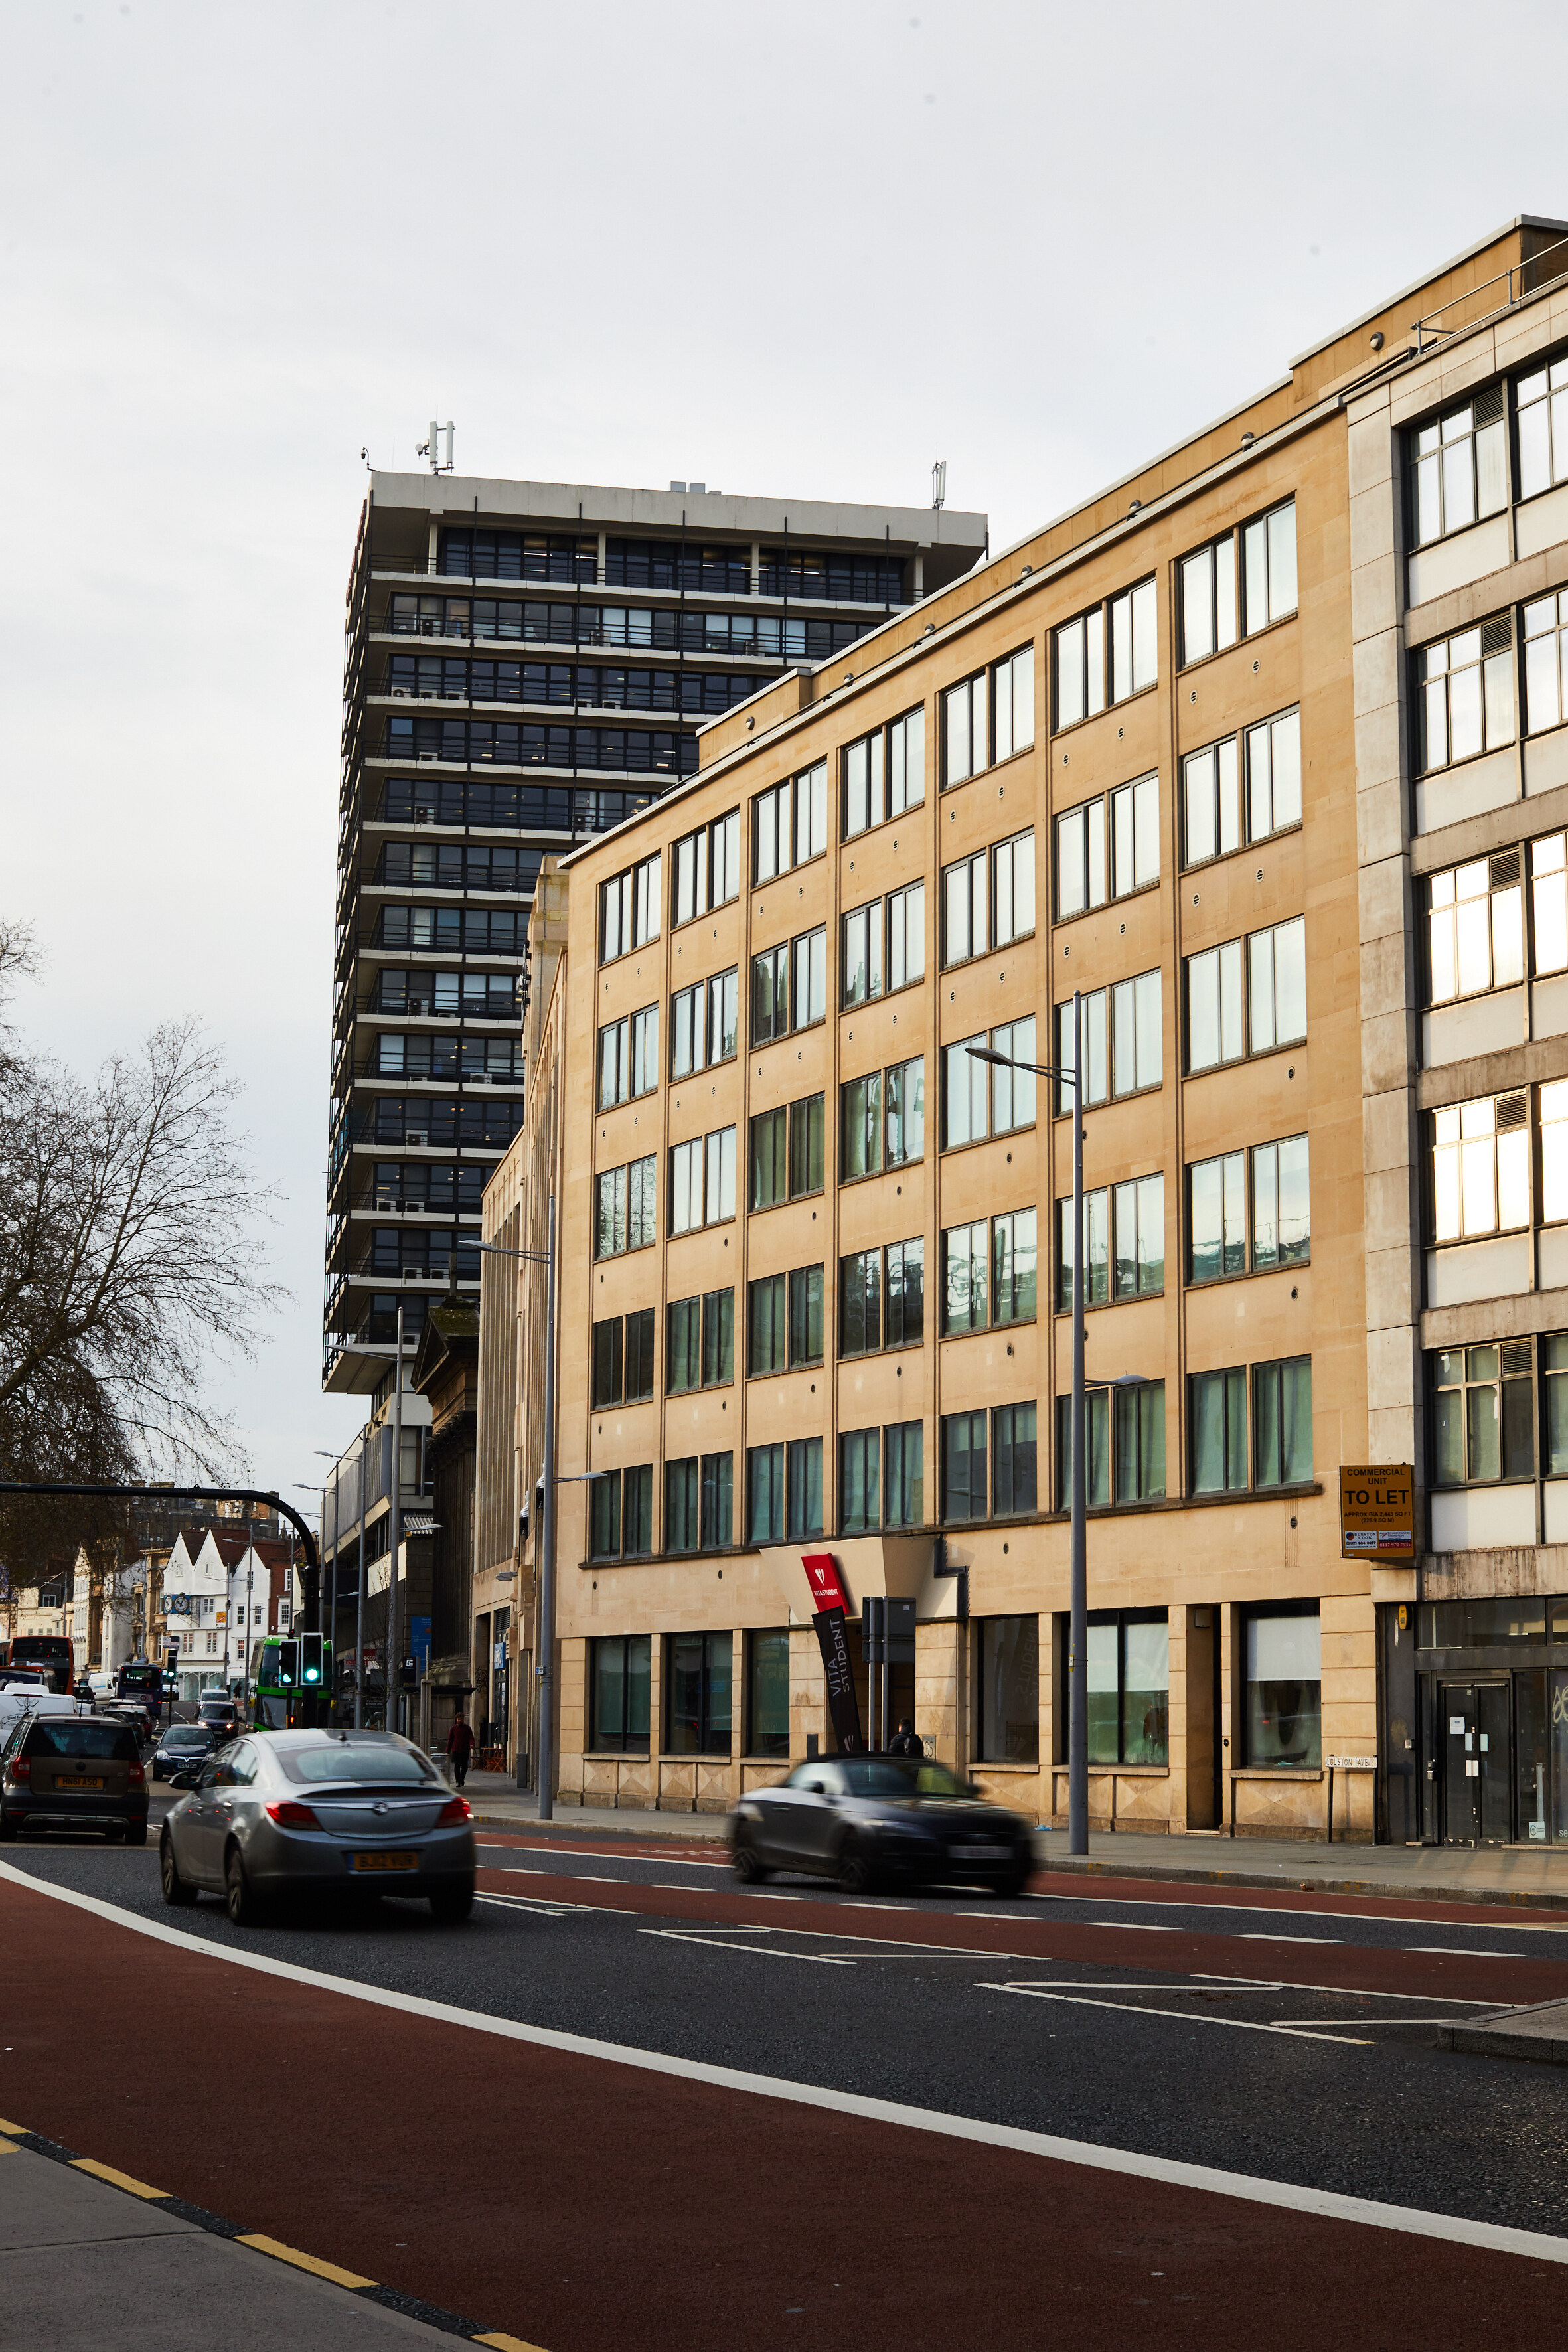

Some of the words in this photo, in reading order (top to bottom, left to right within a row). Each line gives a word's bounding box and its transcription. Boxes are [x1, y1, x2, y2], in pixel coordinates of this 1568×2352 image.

[1344, 1490, 1369, 1504] TO
[1375, 1490, 1409, 1504] LET
[829, 1619, 850, 1693] STUDENT
[828, 1658, 842, 1697] VITA
[924, 1741, 933, 1757] 35
